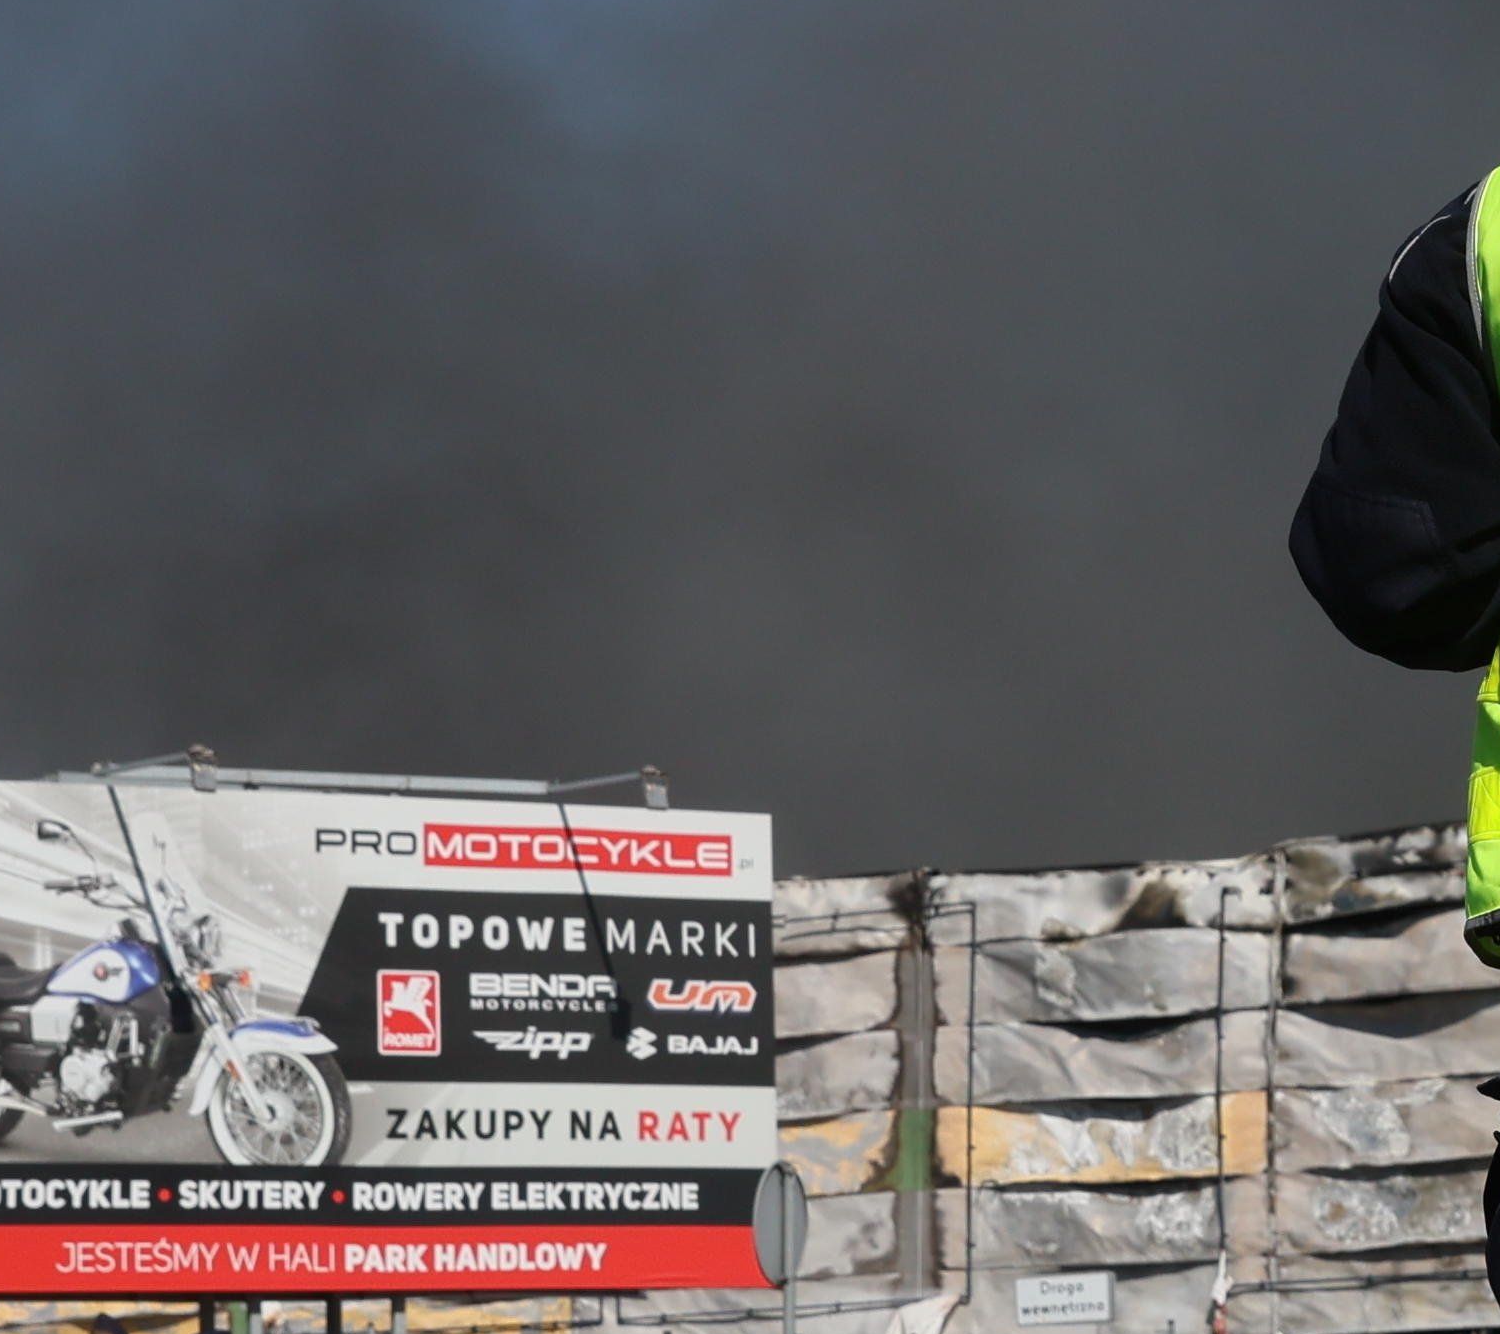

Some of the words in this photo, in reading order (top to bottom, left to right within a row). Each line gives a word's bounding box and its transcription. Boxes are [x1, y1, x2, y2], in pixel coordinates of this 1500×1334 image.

[315, 828, 417, 855] PRO
[426, 831, 730, 870] MOTOCYKLE
[378, 913, 587, 952] TOPOWE
[605, 919, 756, 958] MARKI
[469, 973, 617, 999] BENDA
[383, 1033, 436, 1050] ROMET
[668, 1036, 758, 1056] BAJAJ
[386, 1109, 557, 1142] ZAKUPY
[570, 1111, 621, 1142] NA
[638, 1112, 741, 1143] RATY
[178, 1181, 324, 1210] SKUTERY
[352, 1182, 484, 1212] ROWERY
[491, 1182, 700, 1212] ELEKTRYCZNE
[55, 1237, 219, 1273] JESTEŚMY
[227, 1242, 262, 1272] W
[268, 1242, 336, 1272] HALI
[345, 1244, 427, 1272] PARK
[433, 1242, 607, 1272] HANDLOWY
[1040, 1280, 1084, 1295] Droga
